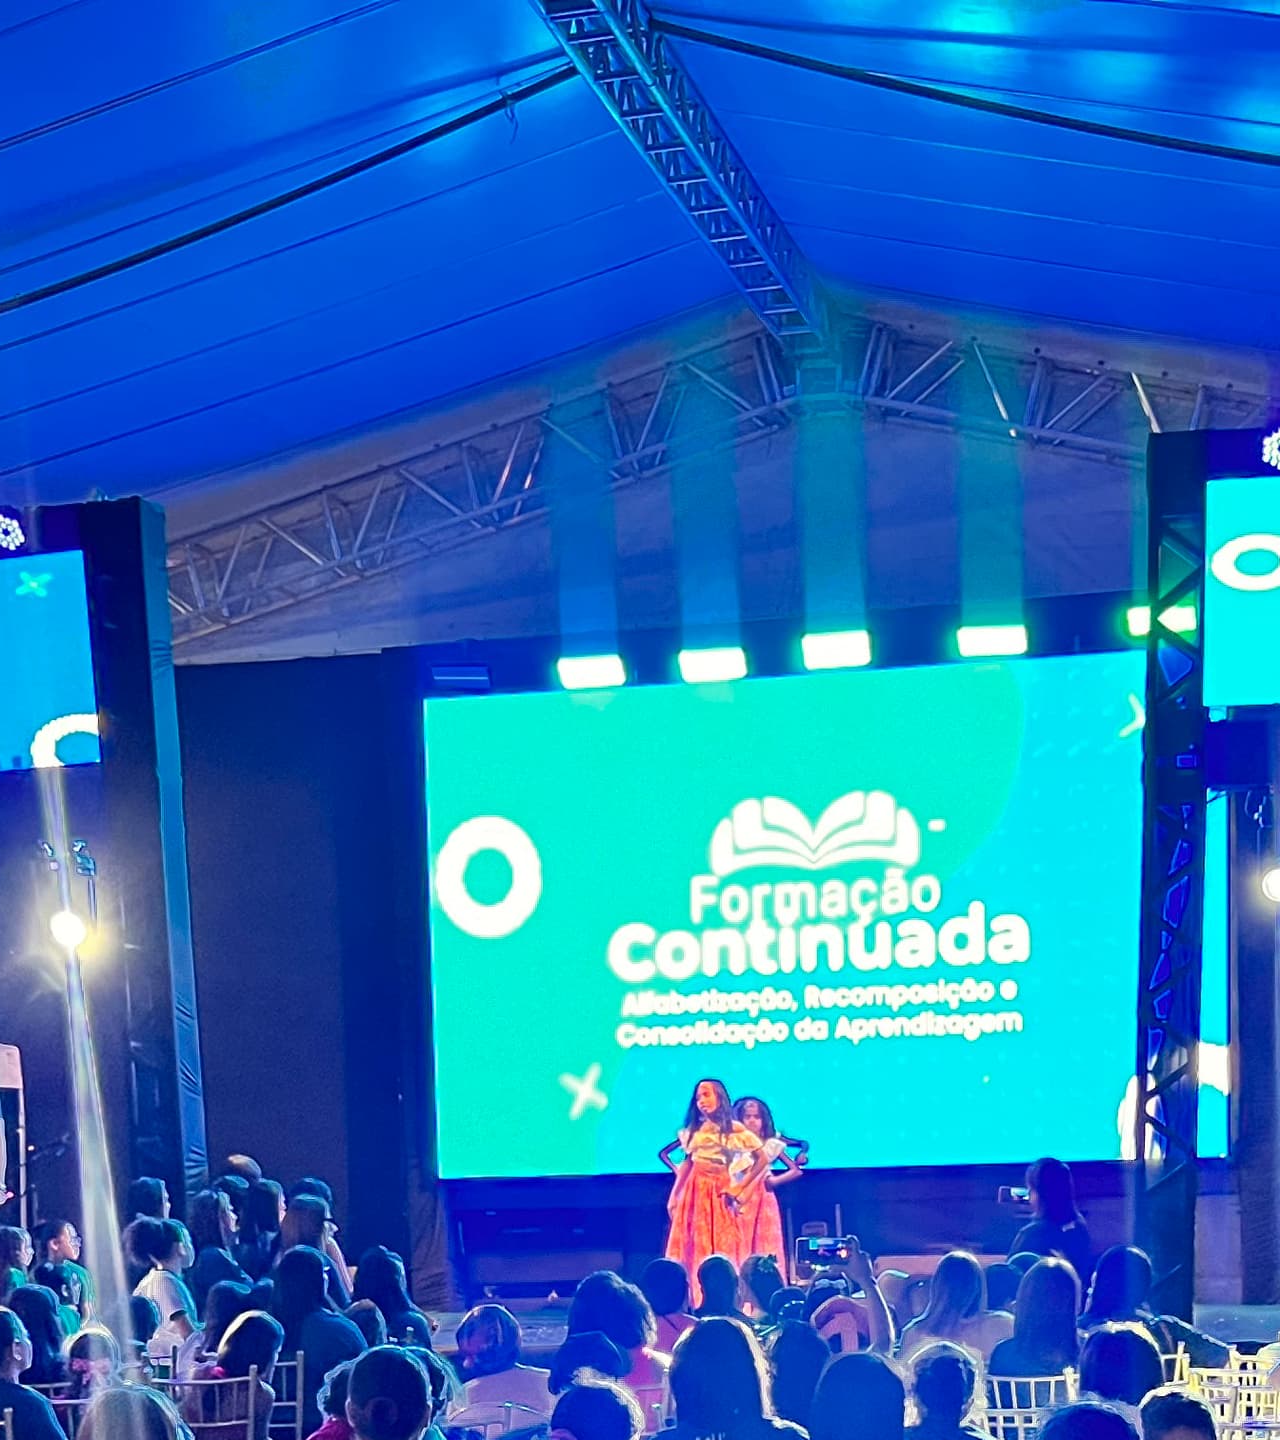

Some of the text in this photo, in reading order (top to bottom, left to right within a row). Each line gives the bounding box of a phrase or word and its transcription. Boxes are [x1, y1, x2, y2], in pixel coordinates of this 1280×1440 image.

[690, 867, 941, 926] Formação
[607, 900, 1032, 983] Continuada
[620, 977, 1019, 1017] Alfabetização, Recomposição e
[615, 1009, 1025, 1049] Consolidação da Aprendizagem
